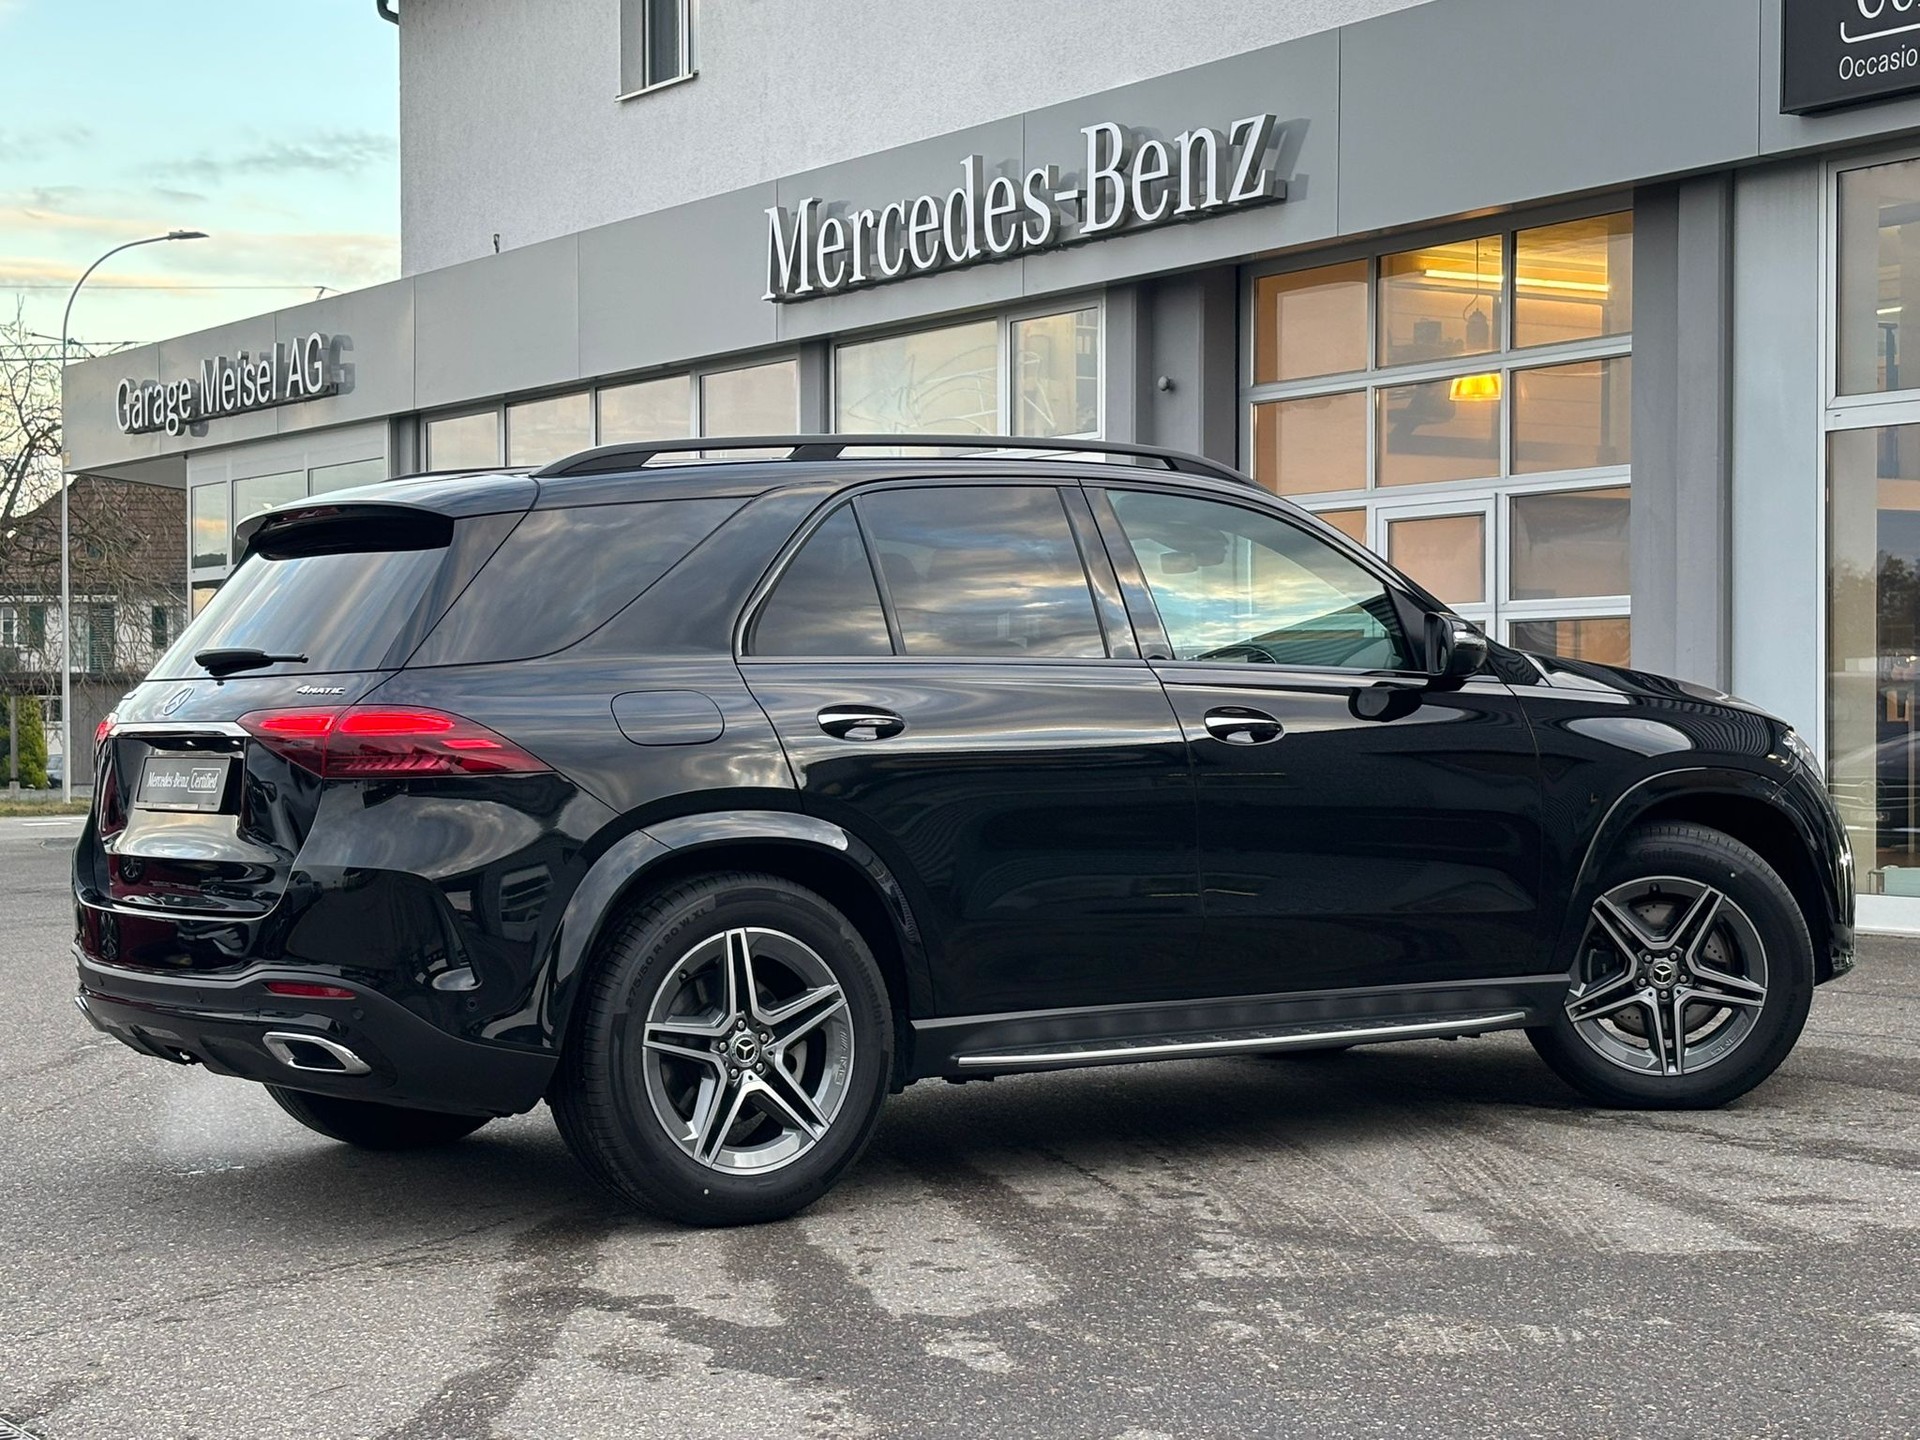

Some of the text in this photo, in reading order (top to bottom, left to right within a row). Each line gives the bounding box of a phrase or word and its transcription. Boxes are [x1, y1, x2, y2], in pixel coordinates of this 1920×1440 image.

[762, 113, 1284, 302] Mercedes-Benz
[115, 331, 329, 437] Garage Meisel AG
[296, 684, 345, 695] 4MATIC
[190, 772, 219, 789] Certified
[625, 955, 655, 1009] 275/50
[662, 926, 680, 945] 20
